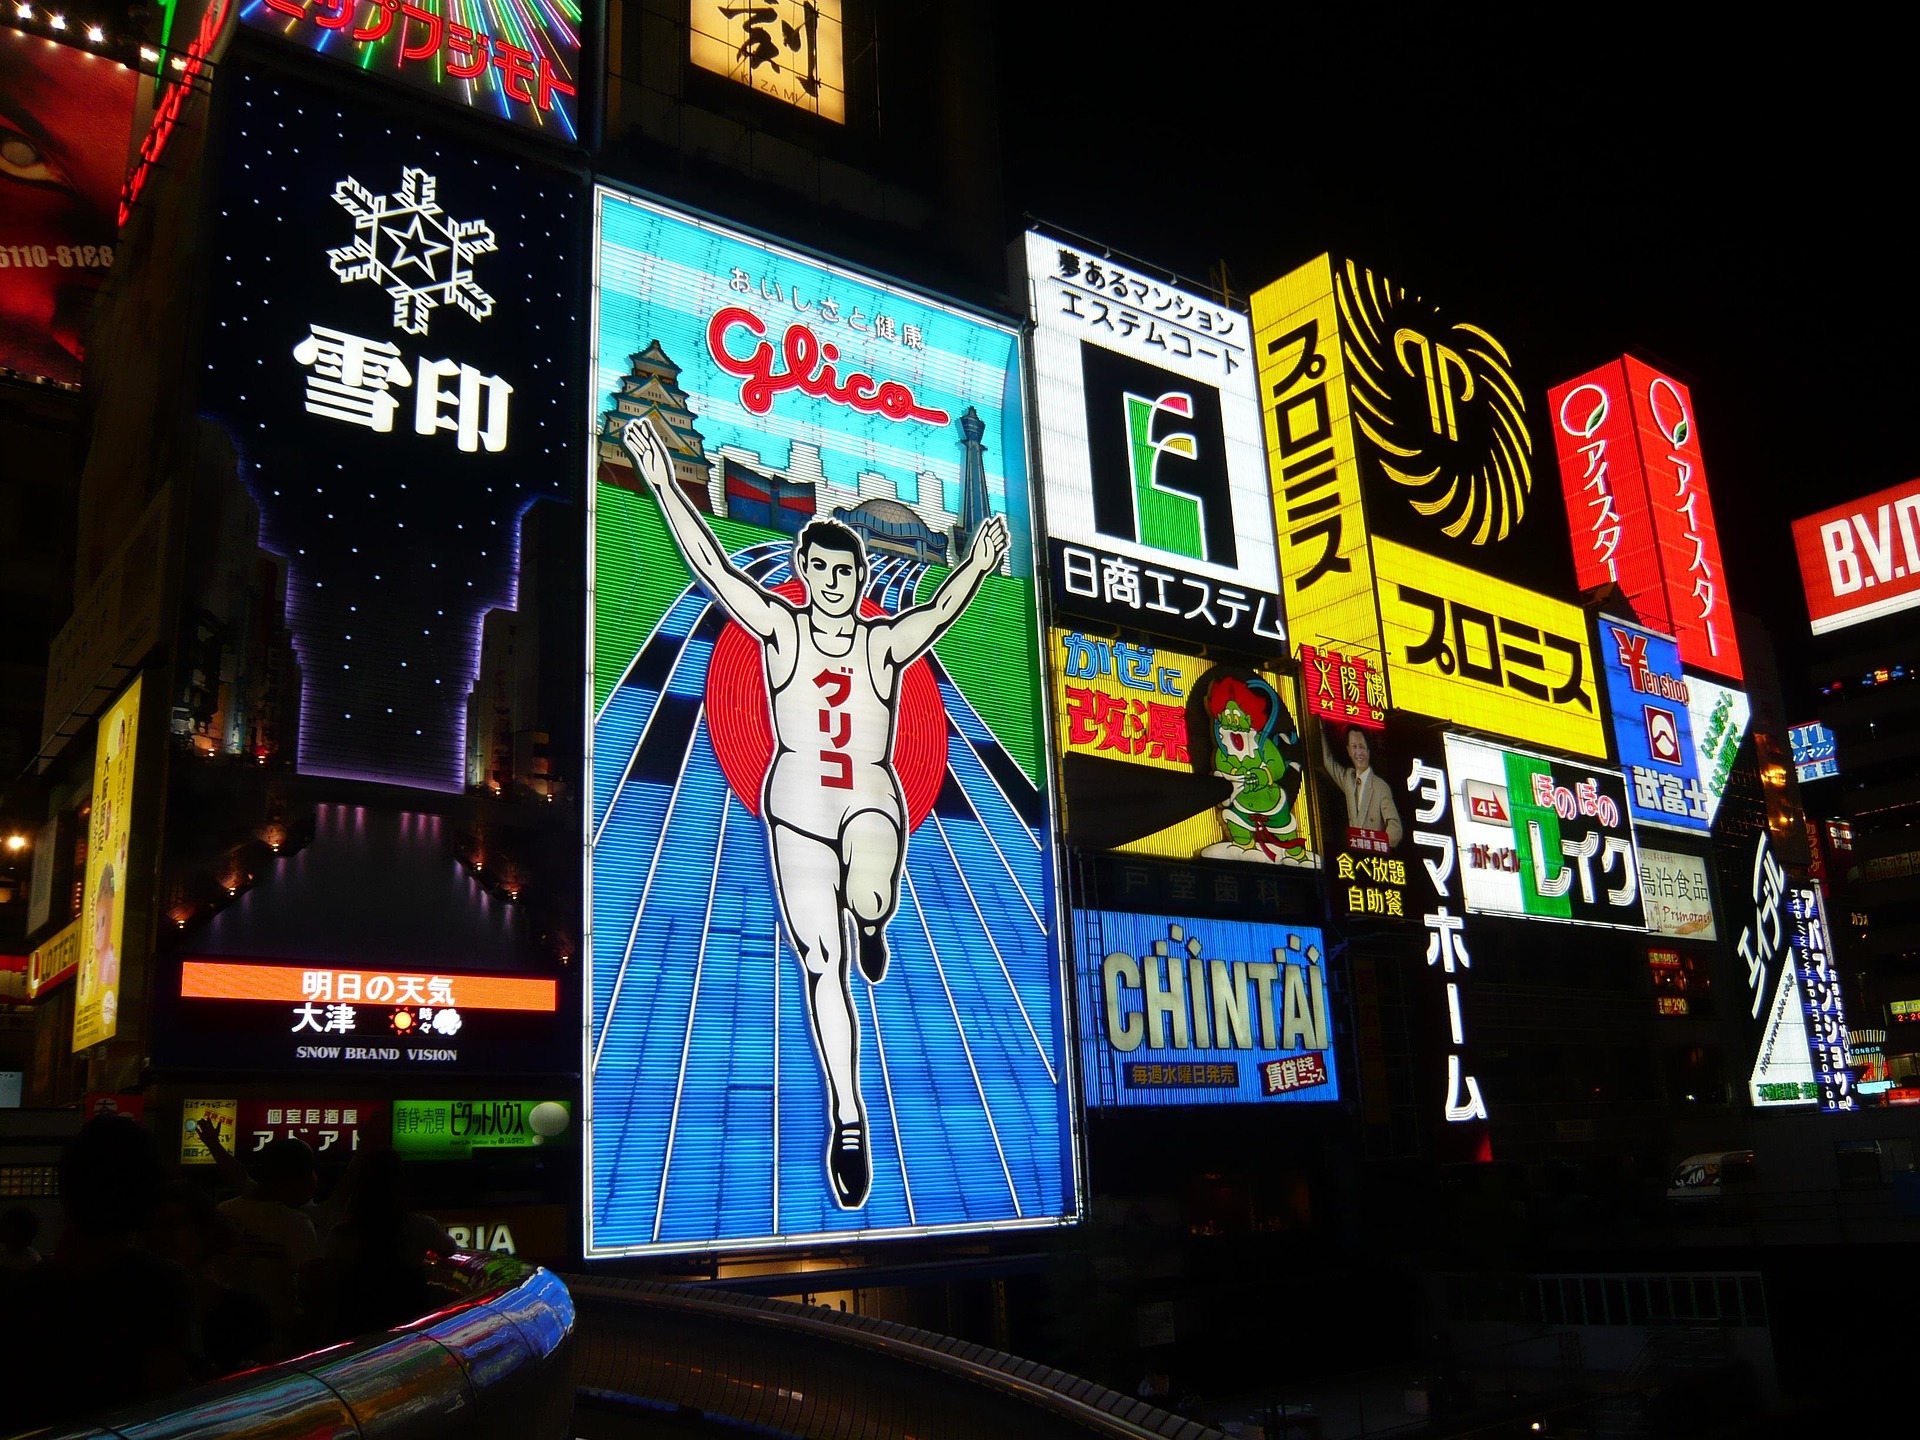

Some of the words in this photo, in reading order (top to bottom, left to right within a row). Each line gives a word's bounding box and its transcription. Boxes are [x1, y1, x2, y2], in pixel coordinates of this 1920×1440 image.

[258, 0, 577, 111] ップフジモト
[729, 266, 924, 351] おいしさと健康
[1057, 249, 1236, 336] 夢あるマンション
[1061, 290, 1239, 376] エステムコート
[294, 323, 513, 452] 雪印
[707, 306, 950, 426] Glico
[1267, 318, 1351, 593] プロミス
[1577, 439, 1622, 583] アイスター
[1063, 546, 1287, 641] 日商エステム
[1667, 455, 1717, 657] アイスター
[1064, 632, 1183, 698] かぜに
[1398, 583, 1592, 714] プロミス
[1660, 672, 1690, 705] shop
[812, 666, 854, 790] グリコ
[1066, 685, 1192, 764] 改源
[1477, 800, 1499, 817] 4F
[1531, 772, 1619, 829] ほのぼの
[1633, 765, 1709, 820] 武富士
[1336, 853, 1406, 885] 食べ放題
[1348, 885, 1404, 917] 自助餐
[1527, 820, 1637, 908] レイク
[1407, 758, 1488, 1122] タマホーム
[291, 1003, 356, 1034] 大津
[302, 971, 455, 1005] 明日の天気
[1103, 923, 1330, 1051] CHINTAI
[1800, 889, 1852, 1111] アパマンショップ
[297, 1046, 340, 1059] SNOW
[345, 1047, 400, 1060] BRAND
[407, 1049, 457, 1061] VISION
[1132, 1064, 1235, 1085] 毎週水曜日発売
[1266, 1062, 1300, 1092] 賃貸
[267, 1109, 357, 1124] 個室居酒屋
[396, 1107, 446, 1134] 賃貸・売買
[451, 1101, 524, 1136] ピタットハウス
